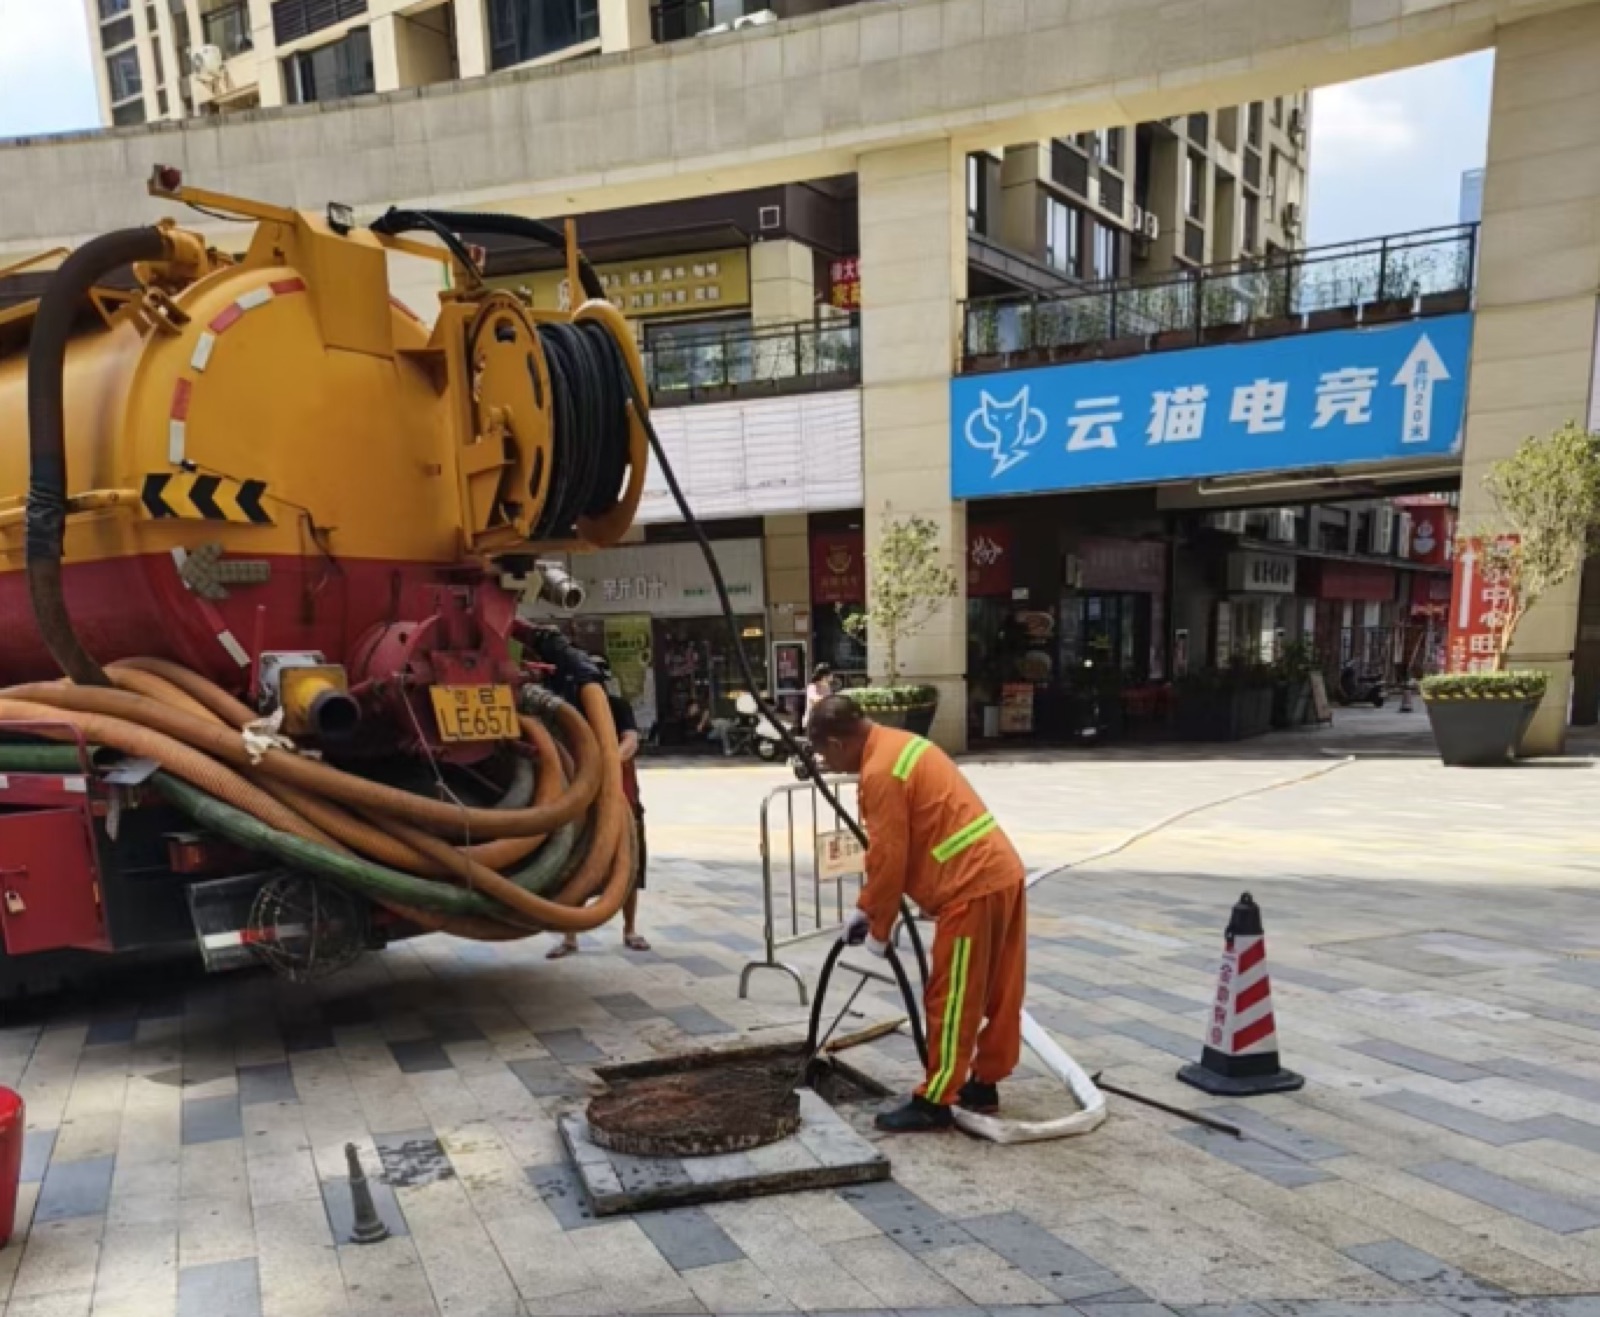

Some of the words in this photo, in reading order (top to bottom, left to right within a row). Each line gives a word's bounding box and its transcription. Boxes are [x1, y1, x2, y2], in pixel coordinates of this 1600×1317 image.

[1064, 366, 1380, 453] 云猫电竞
[438, 705, 512, 737] LE657
